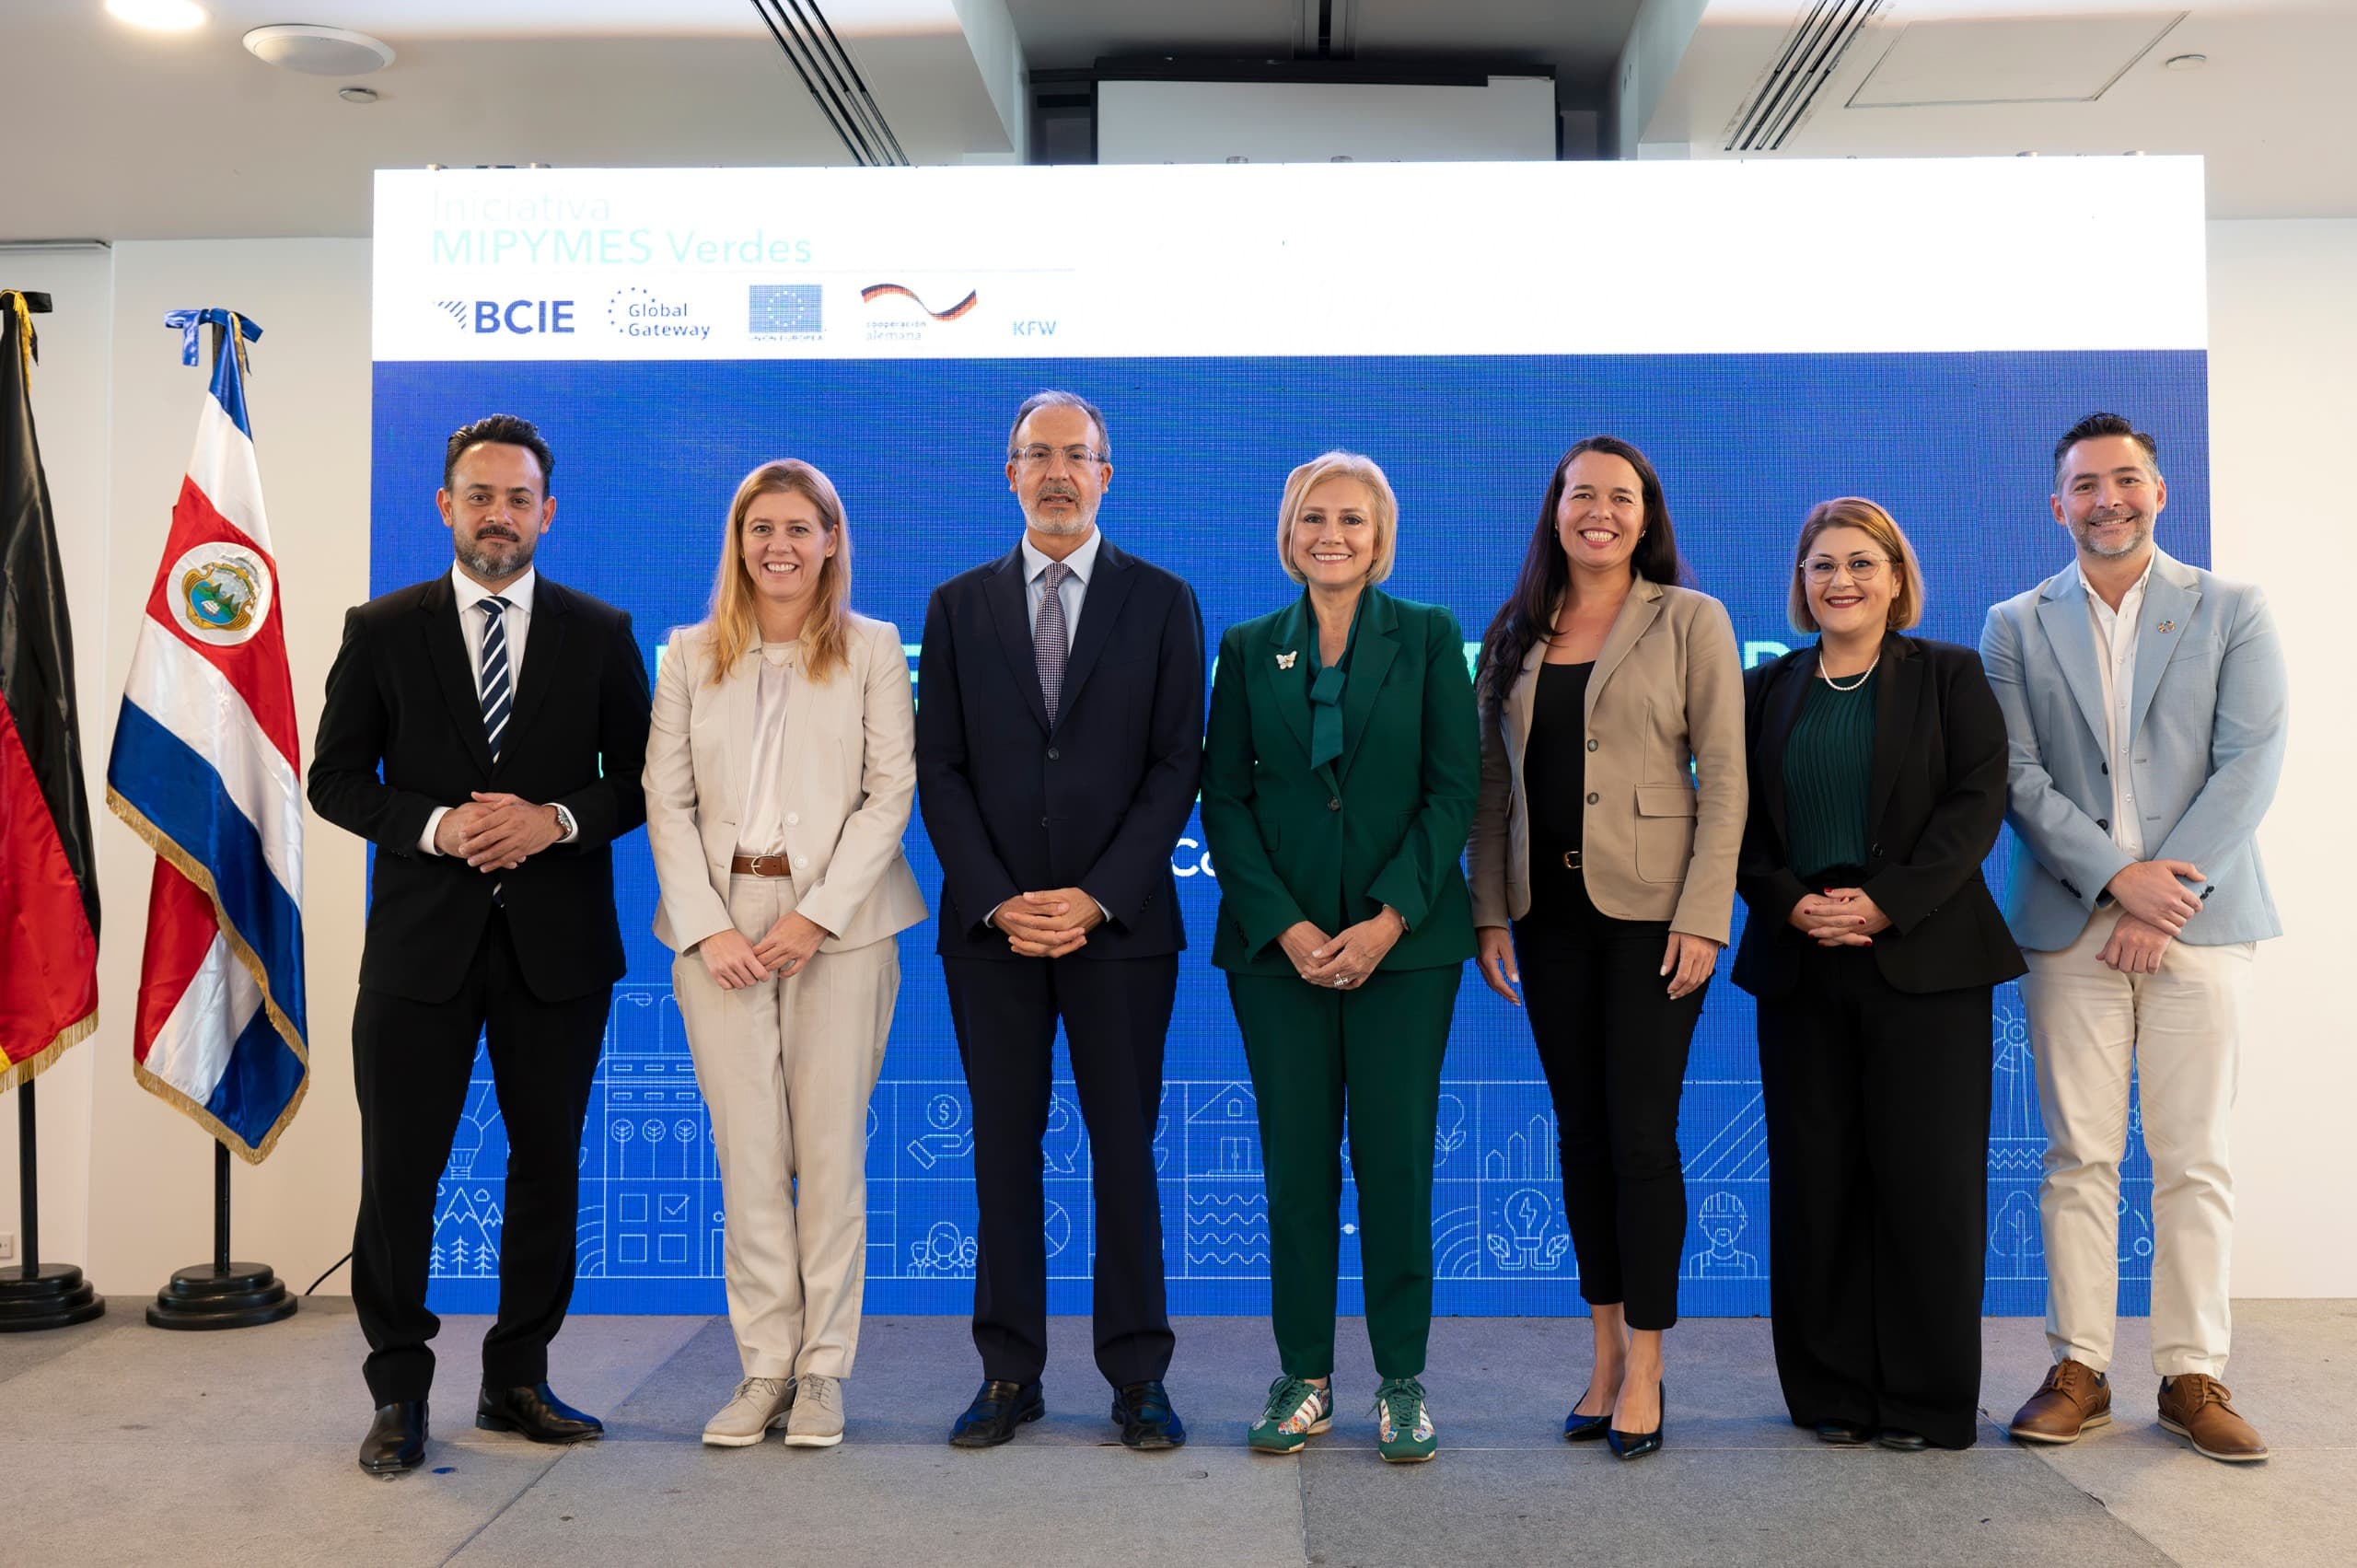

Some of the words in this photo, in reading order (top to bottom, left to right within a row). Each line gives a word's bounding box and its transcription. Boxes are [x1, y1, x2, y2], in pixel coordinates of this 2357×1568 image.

[432, 189, 610, 223] Iniciativa
[433, 229, 652, 265] MIPYMES
[667, 228, 812, 264] Verdes
[474, 299, 575, 335] BCIE
[628, 301, 689, 318] Global
[628, 322, 712, 341] Gateway
[866, 329, 922, 342] alemana
[1012, 320, 1057, 336] KFW
